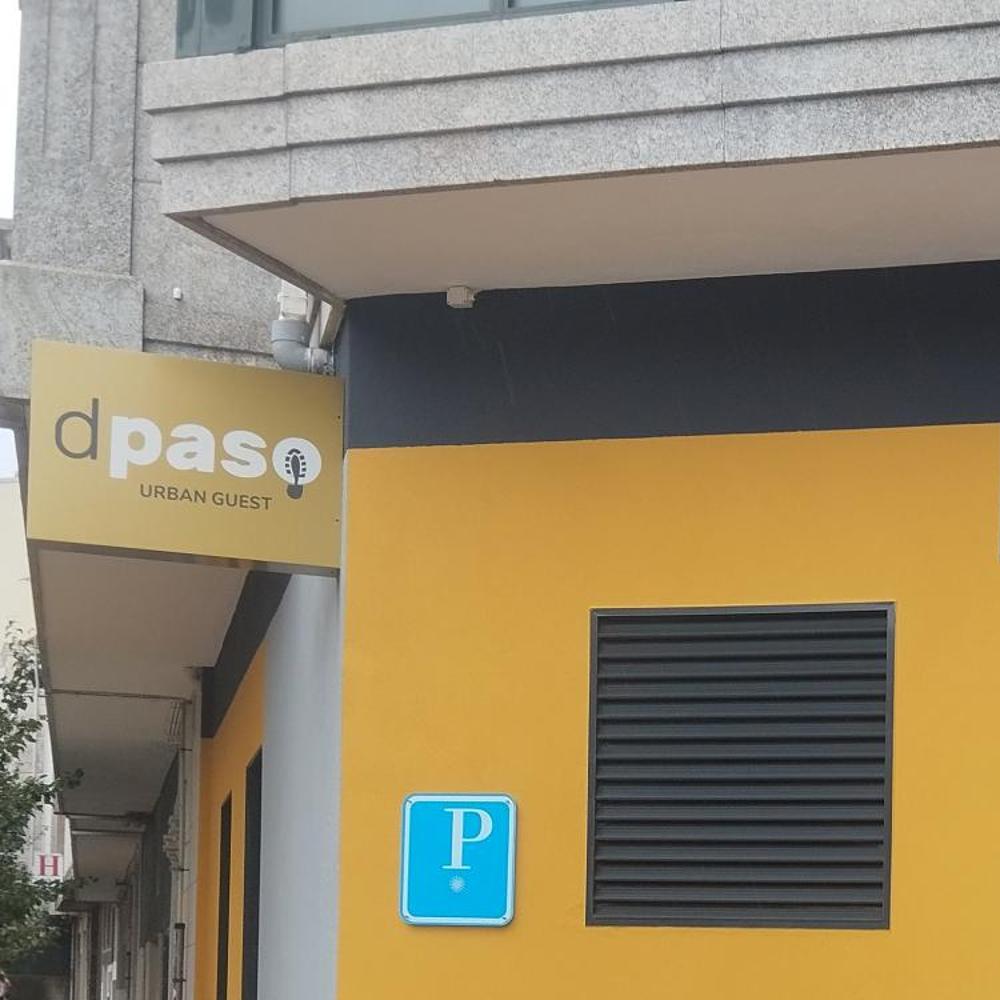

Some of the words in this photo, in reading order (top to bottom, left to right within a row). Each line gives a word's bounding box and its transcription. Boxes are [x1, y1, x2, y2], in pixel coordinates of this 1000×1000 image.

[139, 483, 206, 504] URBAN
[211, 492, 273, 511] GUEST
[442, 808, 493, 870] P
[39, 854, 58, 876] H
